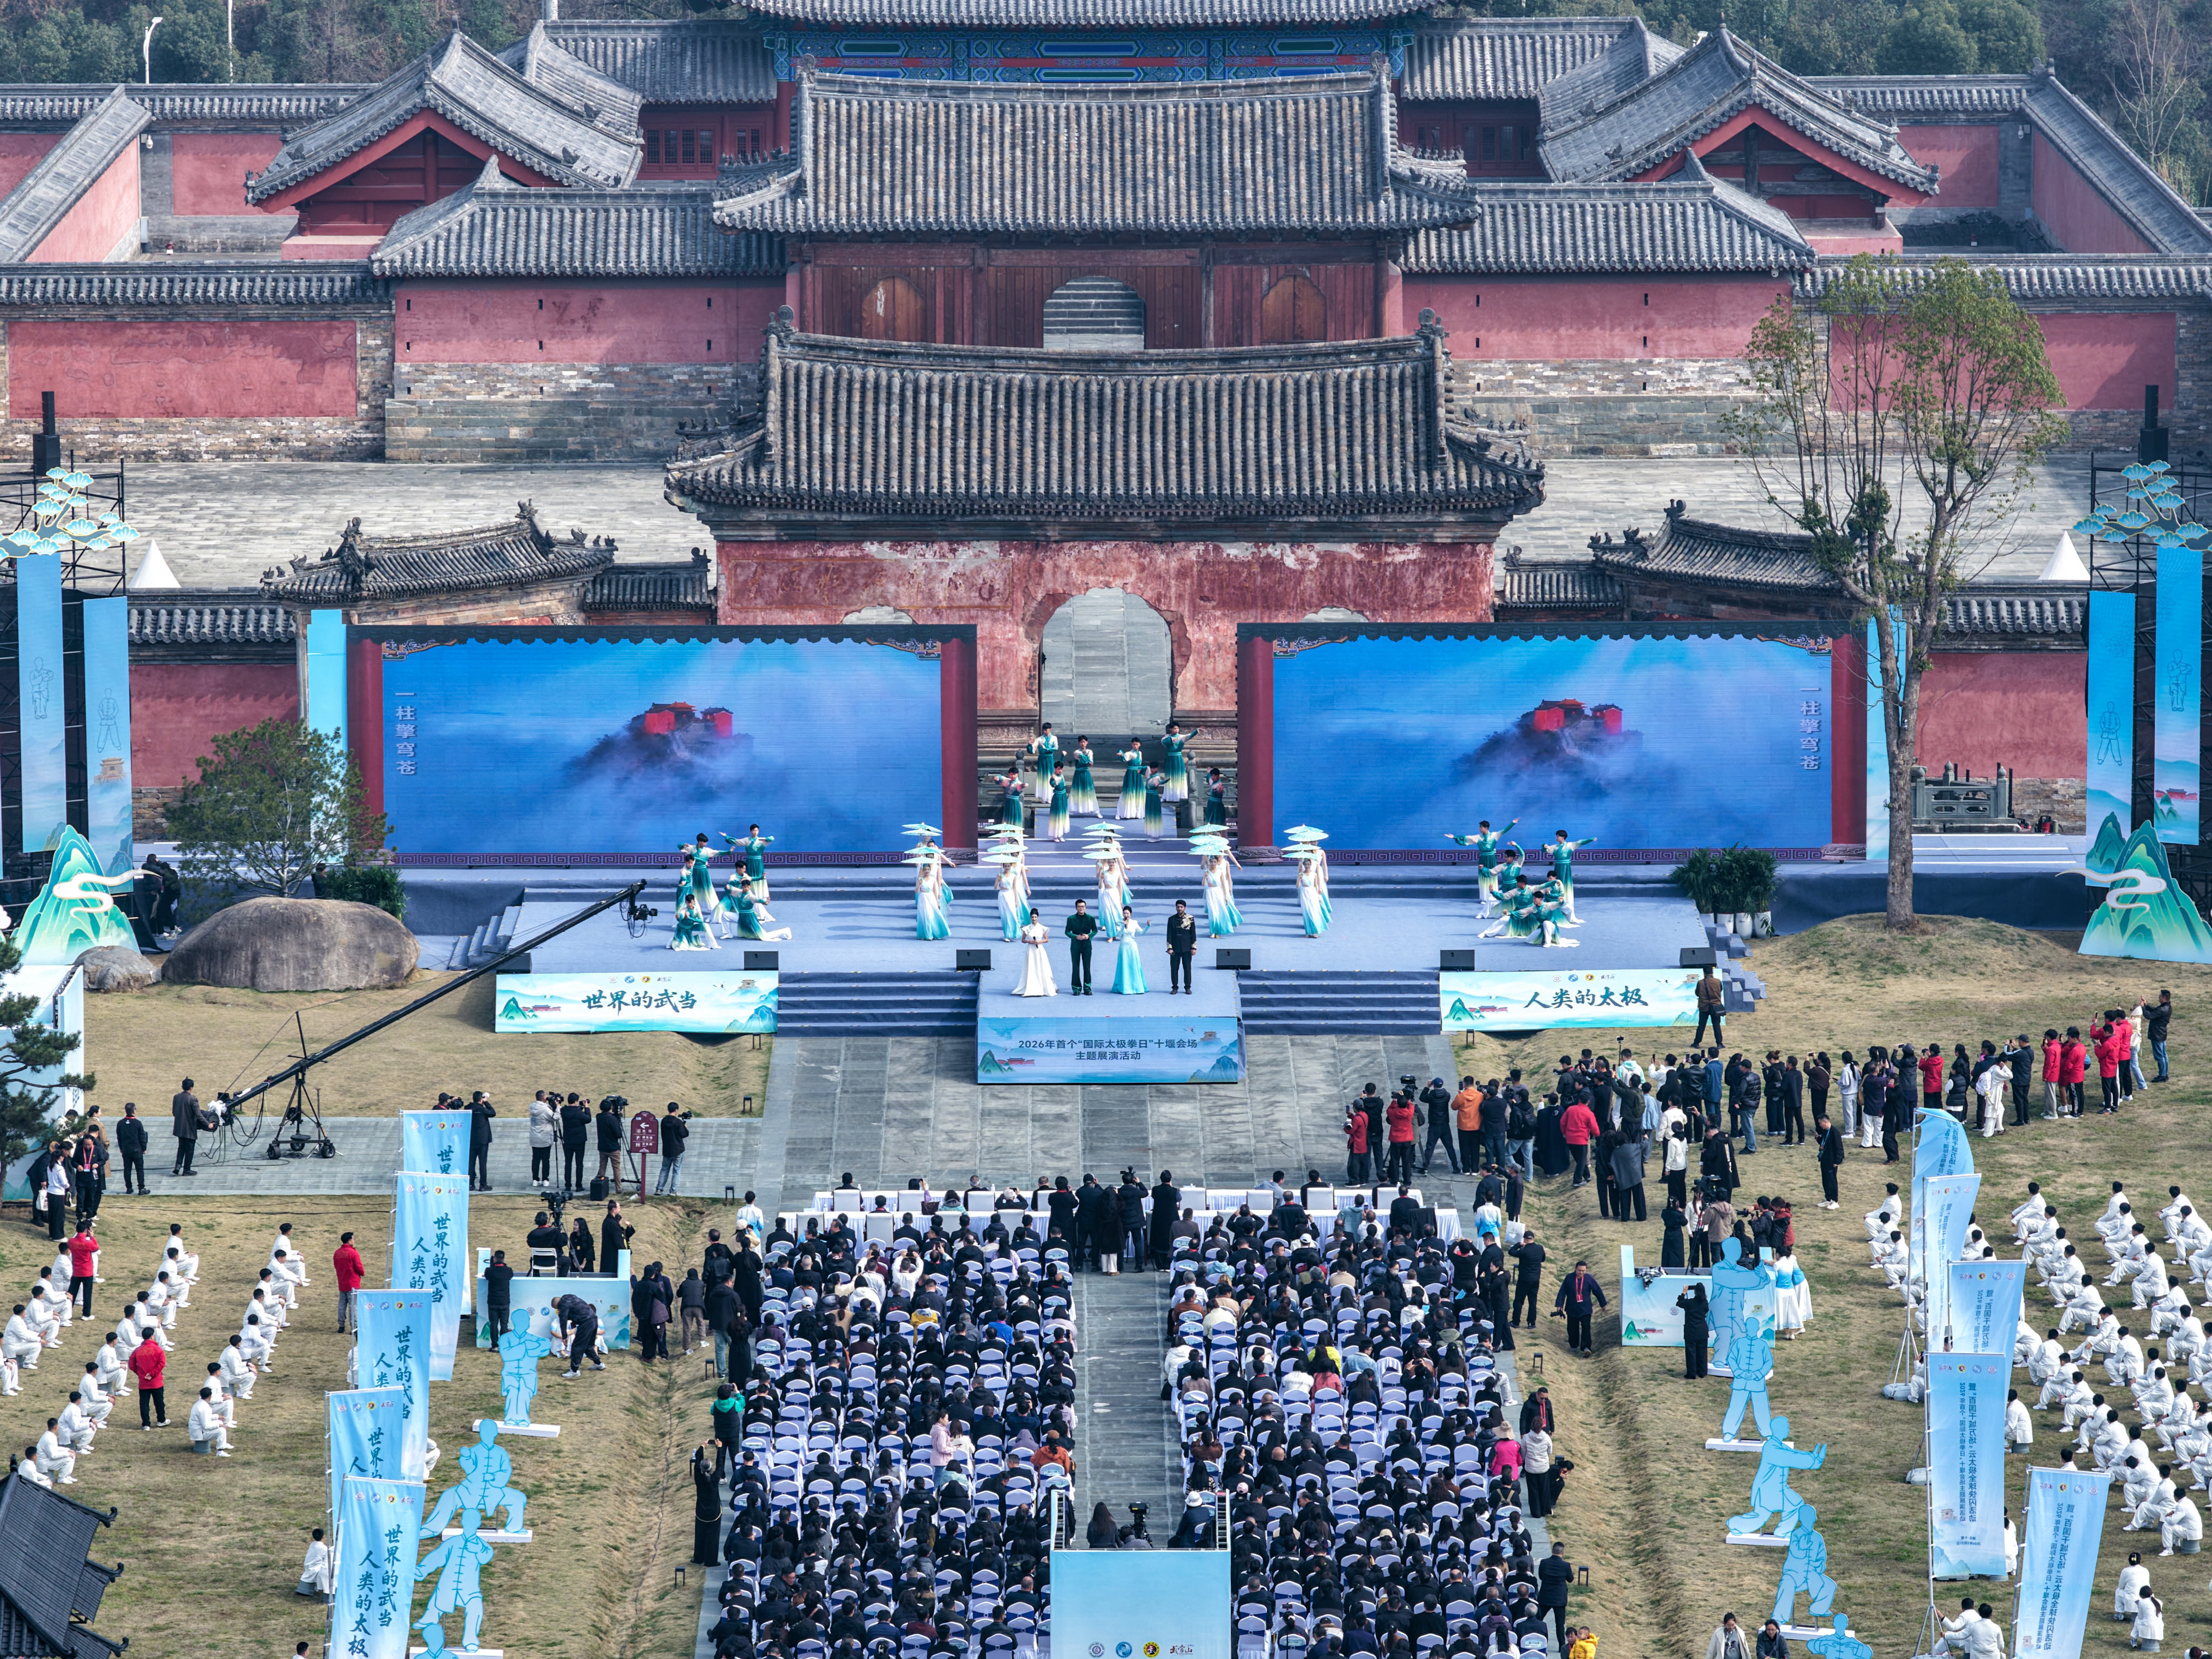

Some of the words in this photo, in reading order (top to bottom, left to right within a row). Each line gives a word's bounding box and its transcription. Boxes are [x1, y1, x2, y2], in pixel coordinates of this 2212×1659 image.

[395, 692, 416, 775] 一柱擎穹苍
[1799, 687, 1820, 770] 一柱擎穹苍
[581, 989, 697, 1015] 世界的武当
[1523, 986, 1648, 1009] 人类的太极
[1019, 1038, 1197, 1049] 2026年首个“国际太极拳日”十堰会场
[1075, 1051, 1141, 1061] 主题展演活动
[430, 1213, 450, 1303] 世界的武当
[348, 1550, 381, 1658] 人类的太极
[378, 1524, 403, 1627] 世界的武当
